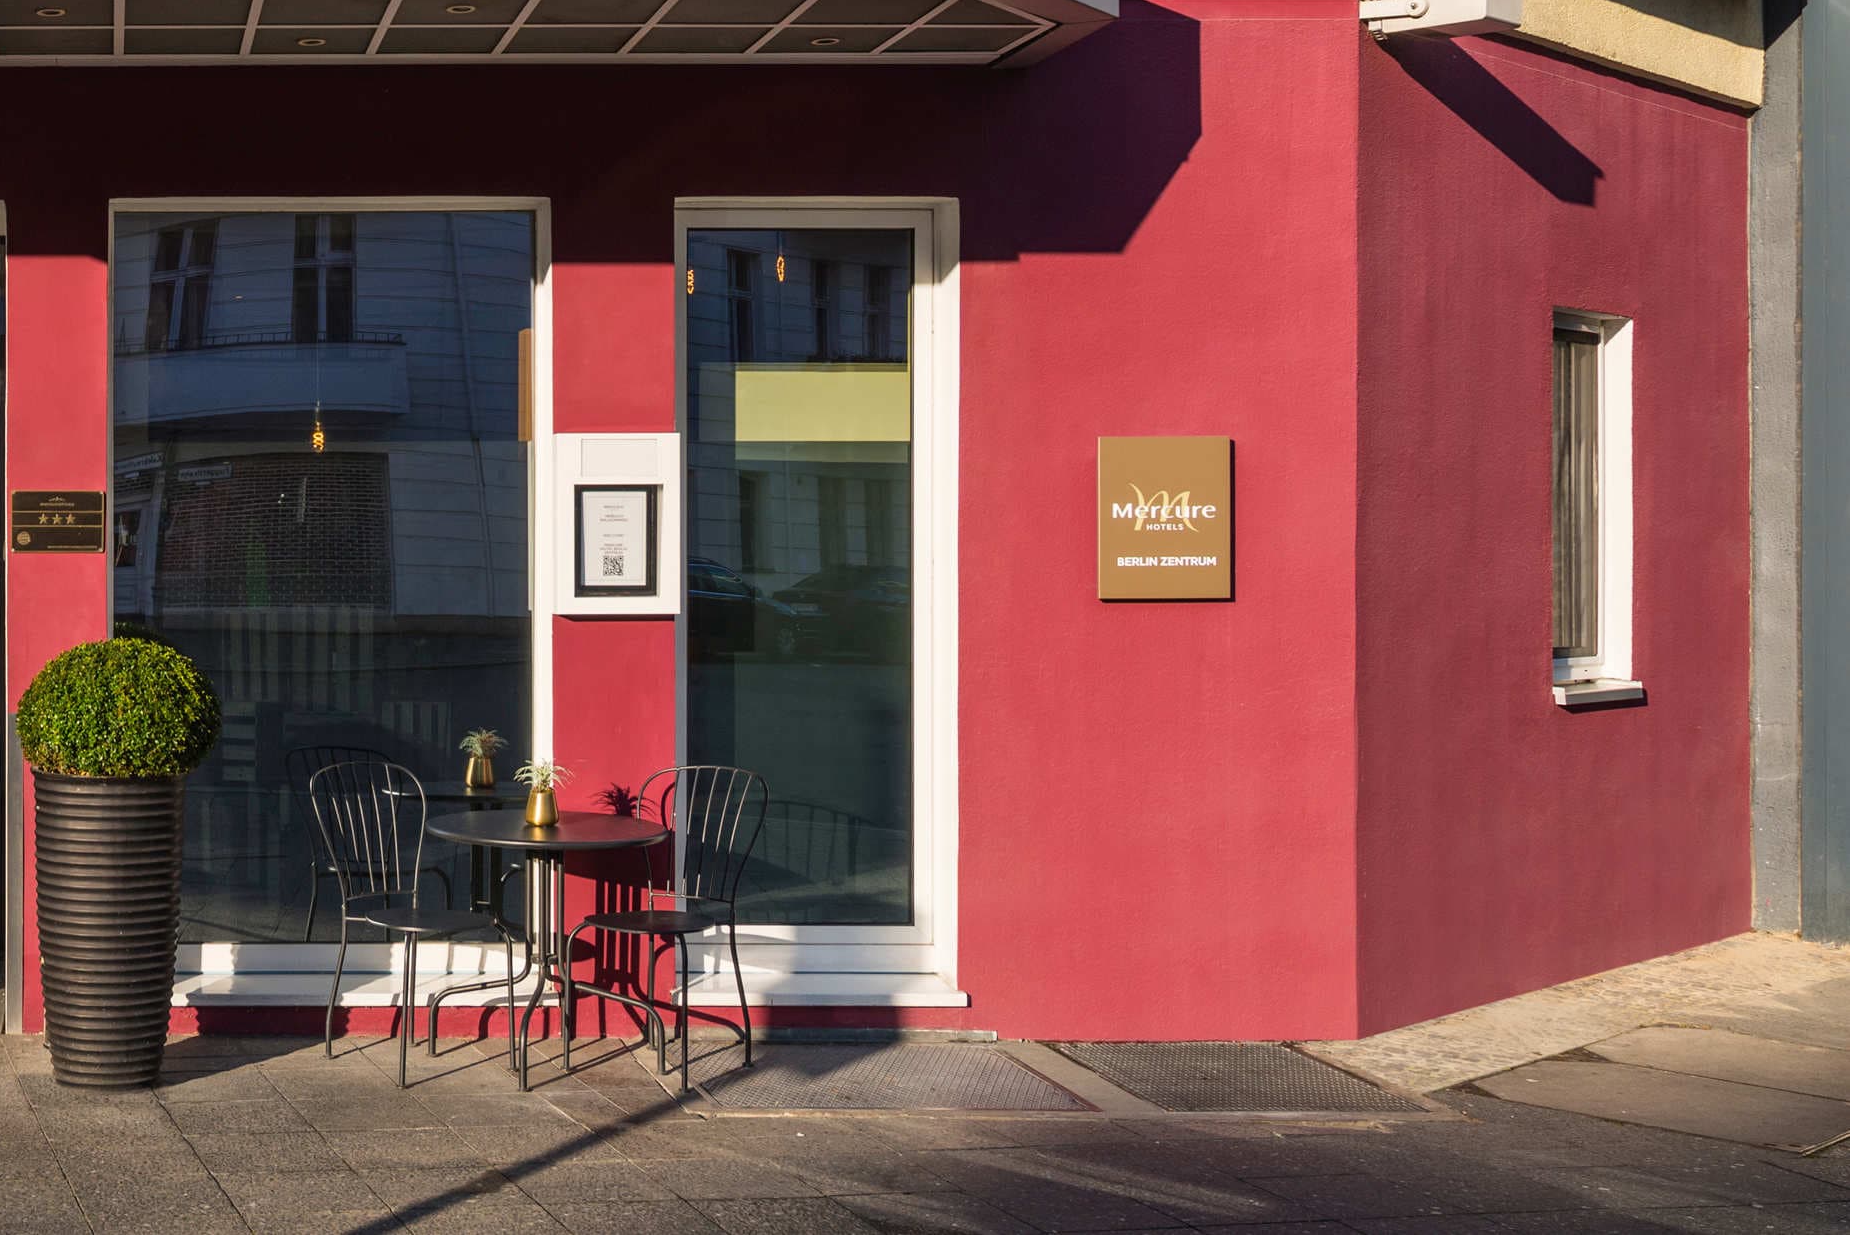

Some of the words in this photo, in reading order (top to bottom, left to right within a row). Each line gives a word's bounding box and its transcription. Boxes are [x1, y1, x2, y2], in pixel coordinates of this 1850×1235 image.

[1111, 503, 1217, 519] Mercure
[1146, 523, 1185, 531] HOTELS
[1117, 556, 1158, 567] BERLIN
[1160, 556, 1217, 567] ZENTRUM
